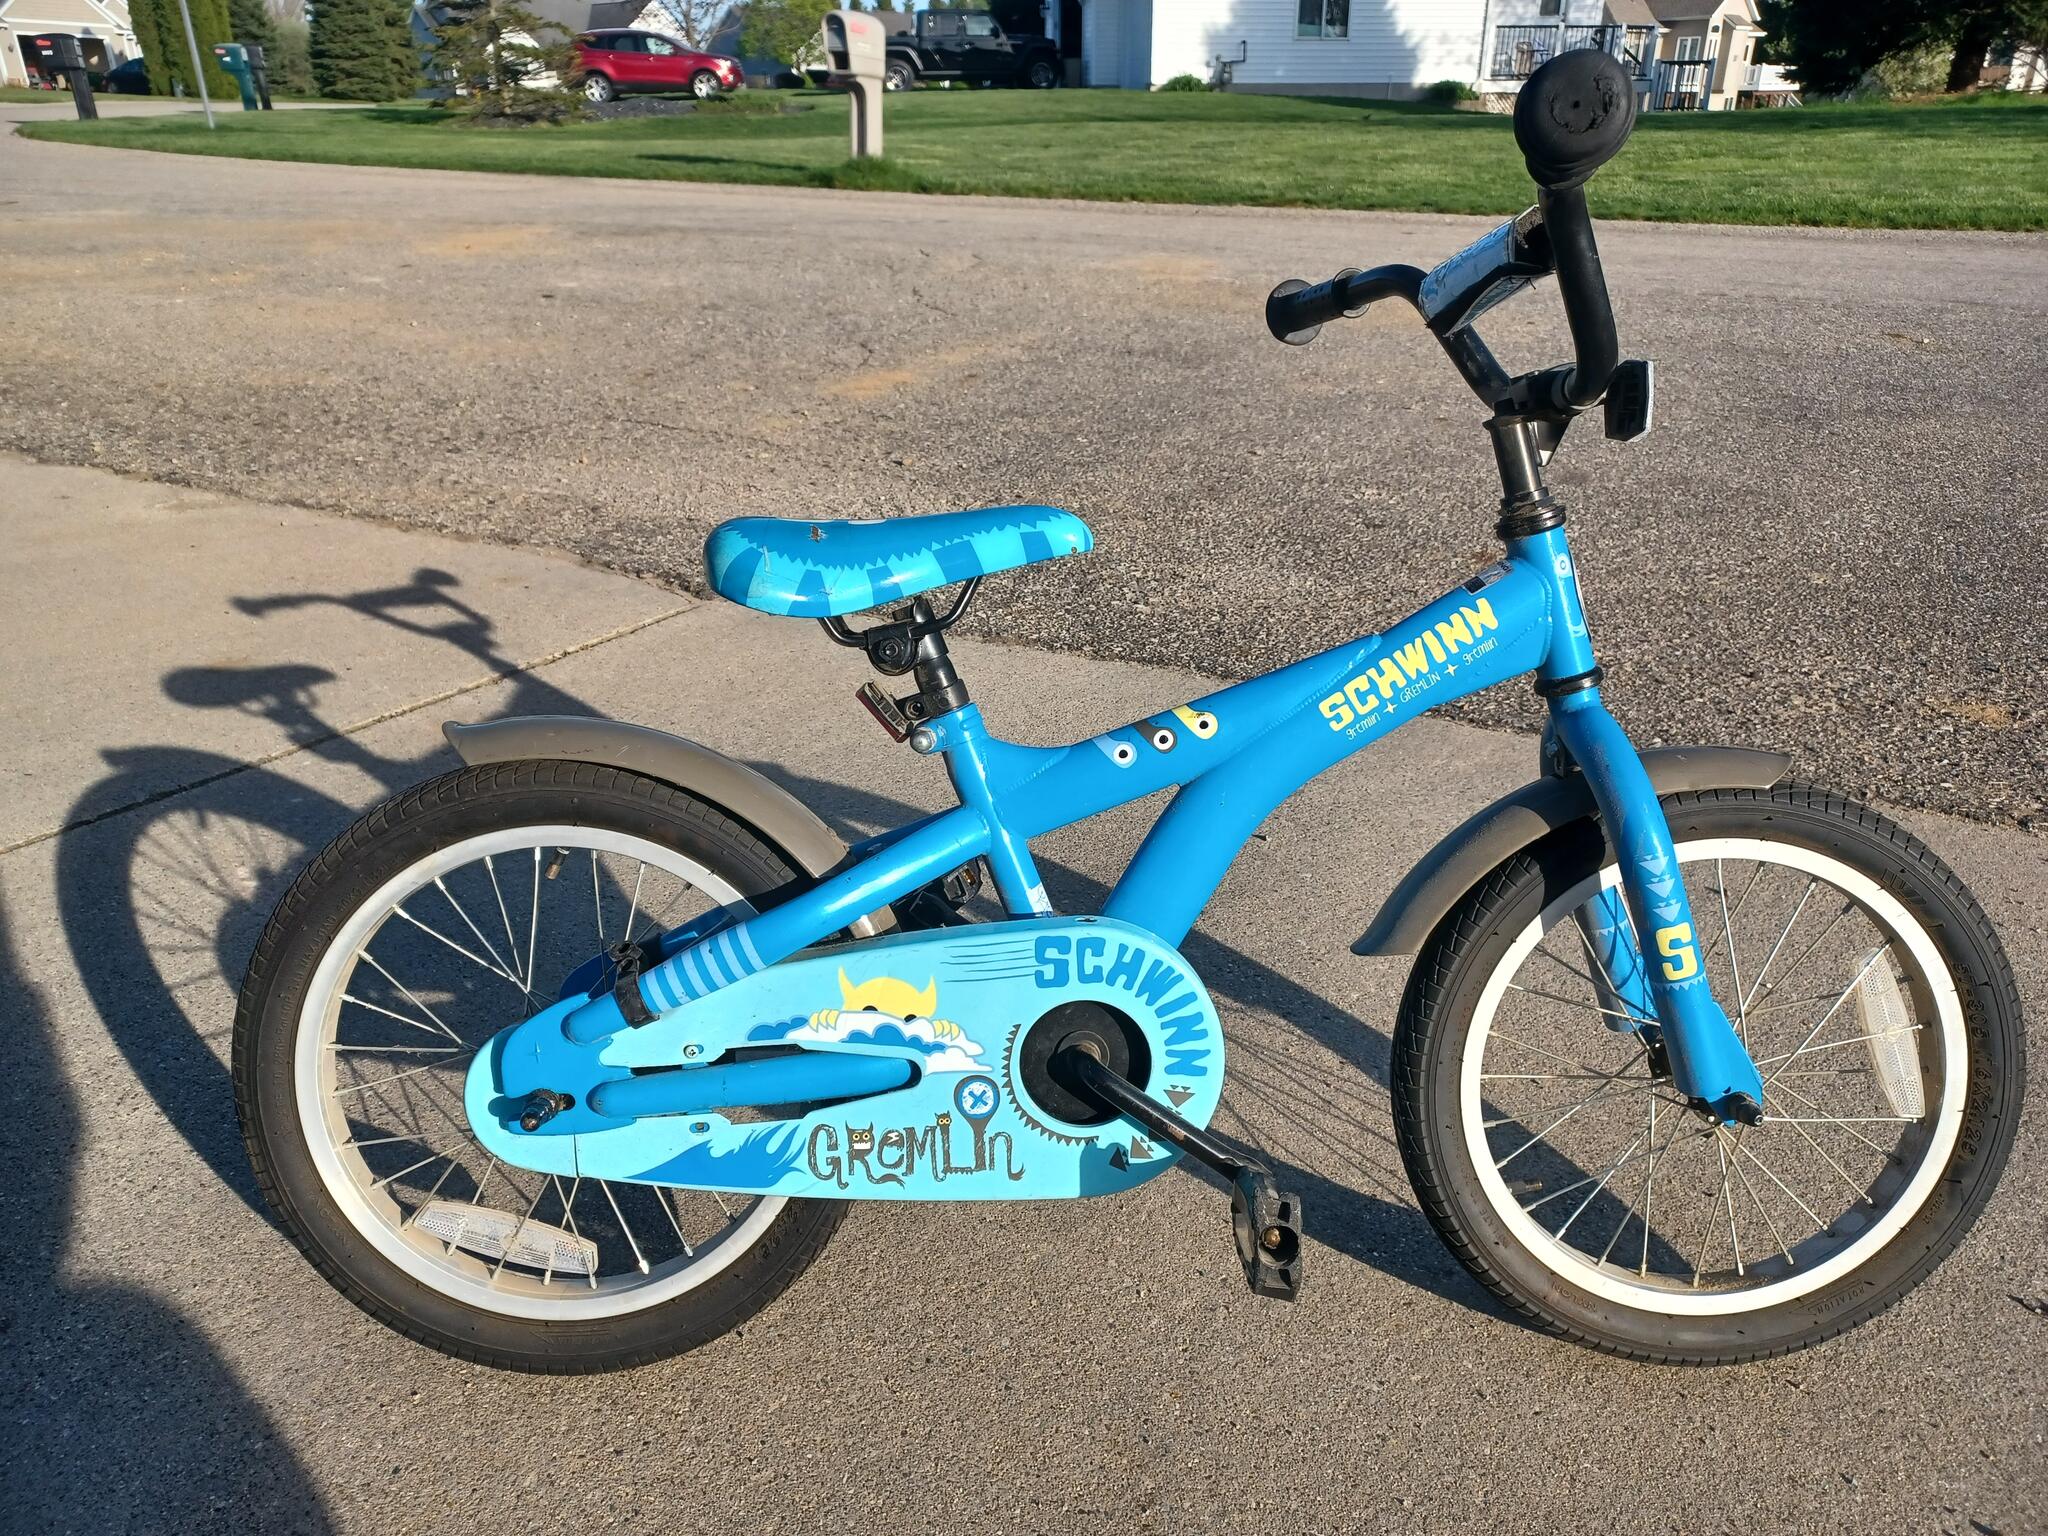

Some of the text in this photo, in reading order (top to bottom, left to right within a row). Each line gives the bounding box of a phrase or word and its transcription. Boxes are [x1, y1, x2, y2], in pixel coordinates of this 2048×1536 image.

[1318, 597, 1499, 732] SCHWINN
[1400, 671, 1441, 703] GREMLIN
[1655, 921, 1698, 981] S
[1034, 935, 1211, 1077] SCHWINN
[1816, 1286, 1865, 1315] ROTATION
